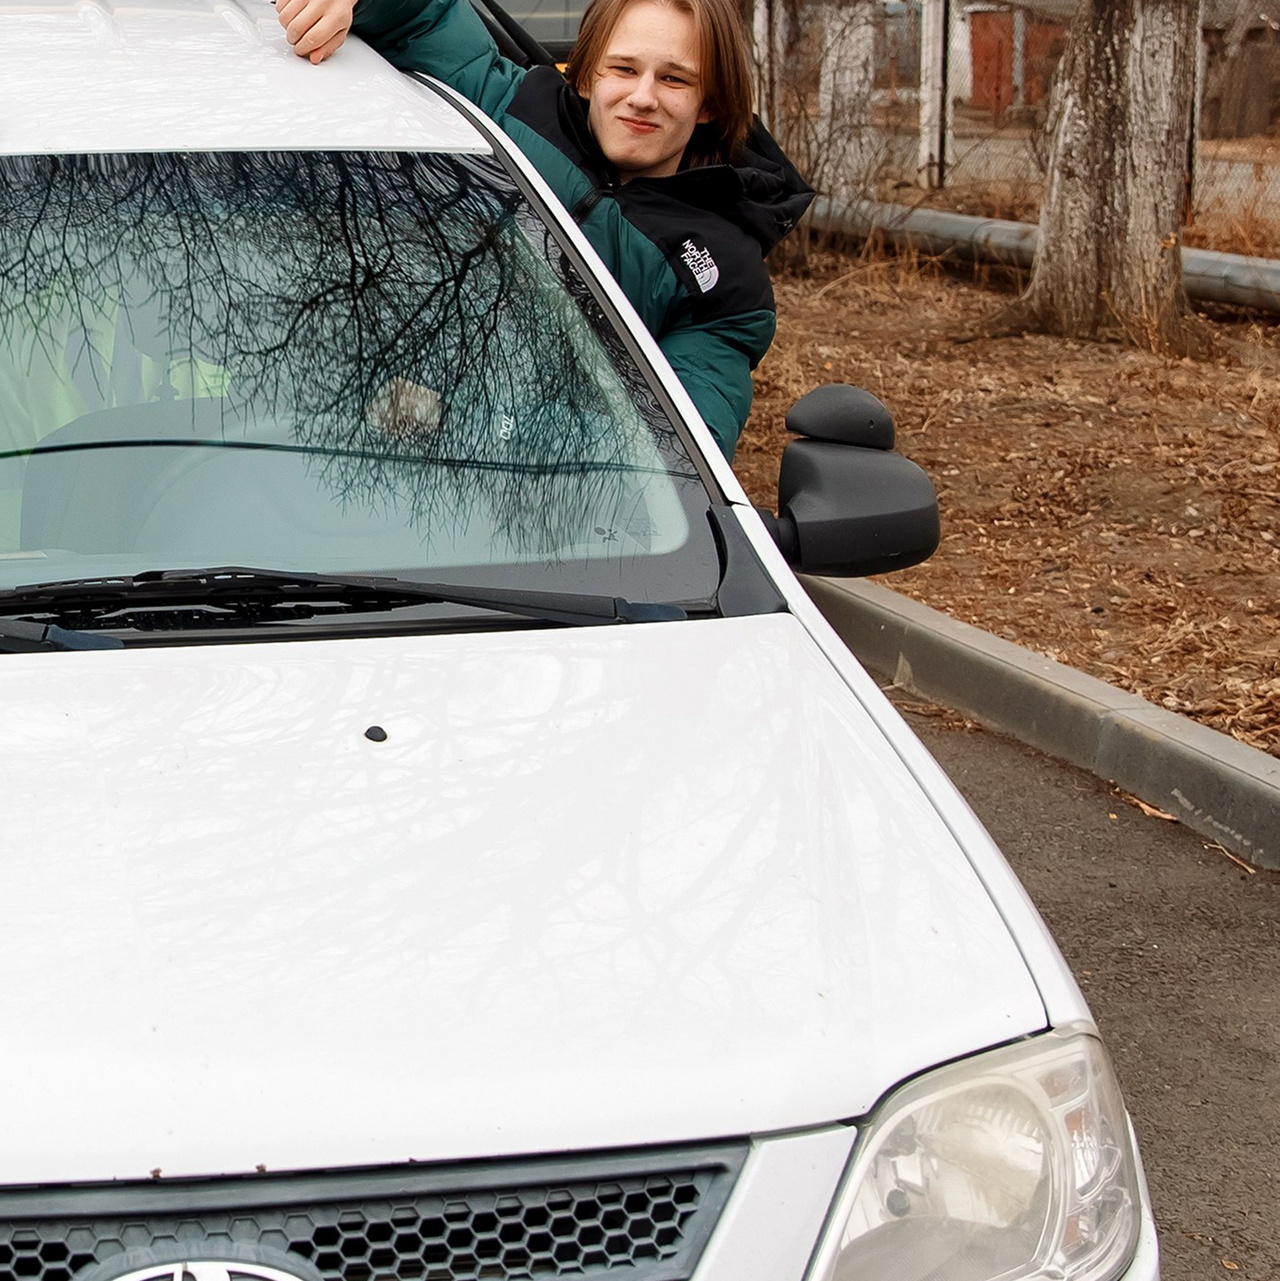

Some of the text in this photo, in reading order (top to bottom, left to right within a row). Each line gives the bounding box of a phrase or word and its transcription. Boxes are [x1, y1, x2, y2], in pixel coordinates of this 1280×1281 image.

[681, 252, 701, 276] FACE
[682, 239, 710, 273] NORTH
[701, 247, 716, 268] THE
